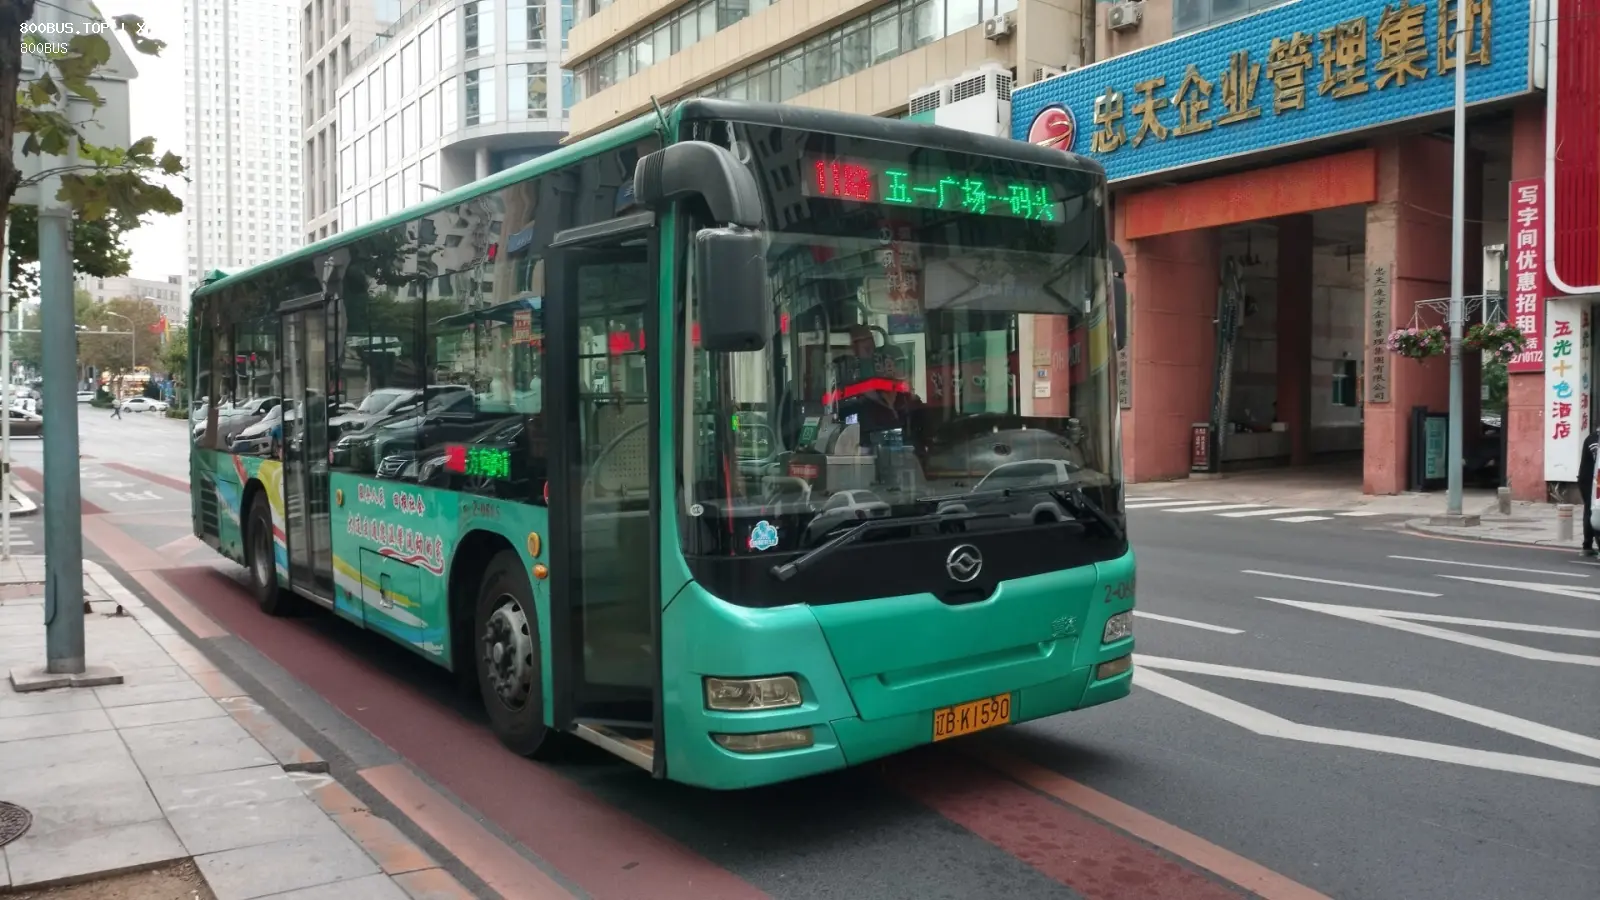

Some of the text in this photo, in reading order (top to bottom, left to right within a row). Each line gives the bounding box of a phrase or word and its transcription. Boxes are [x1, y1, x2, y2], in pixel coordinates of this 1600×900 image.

[1090, 0, 1493, 154] 忠天企业管理集团
[1515, 184, 1539, 334] 写字间优惠招租
[1552, 319, 1573, 440] 五光十色酒店
